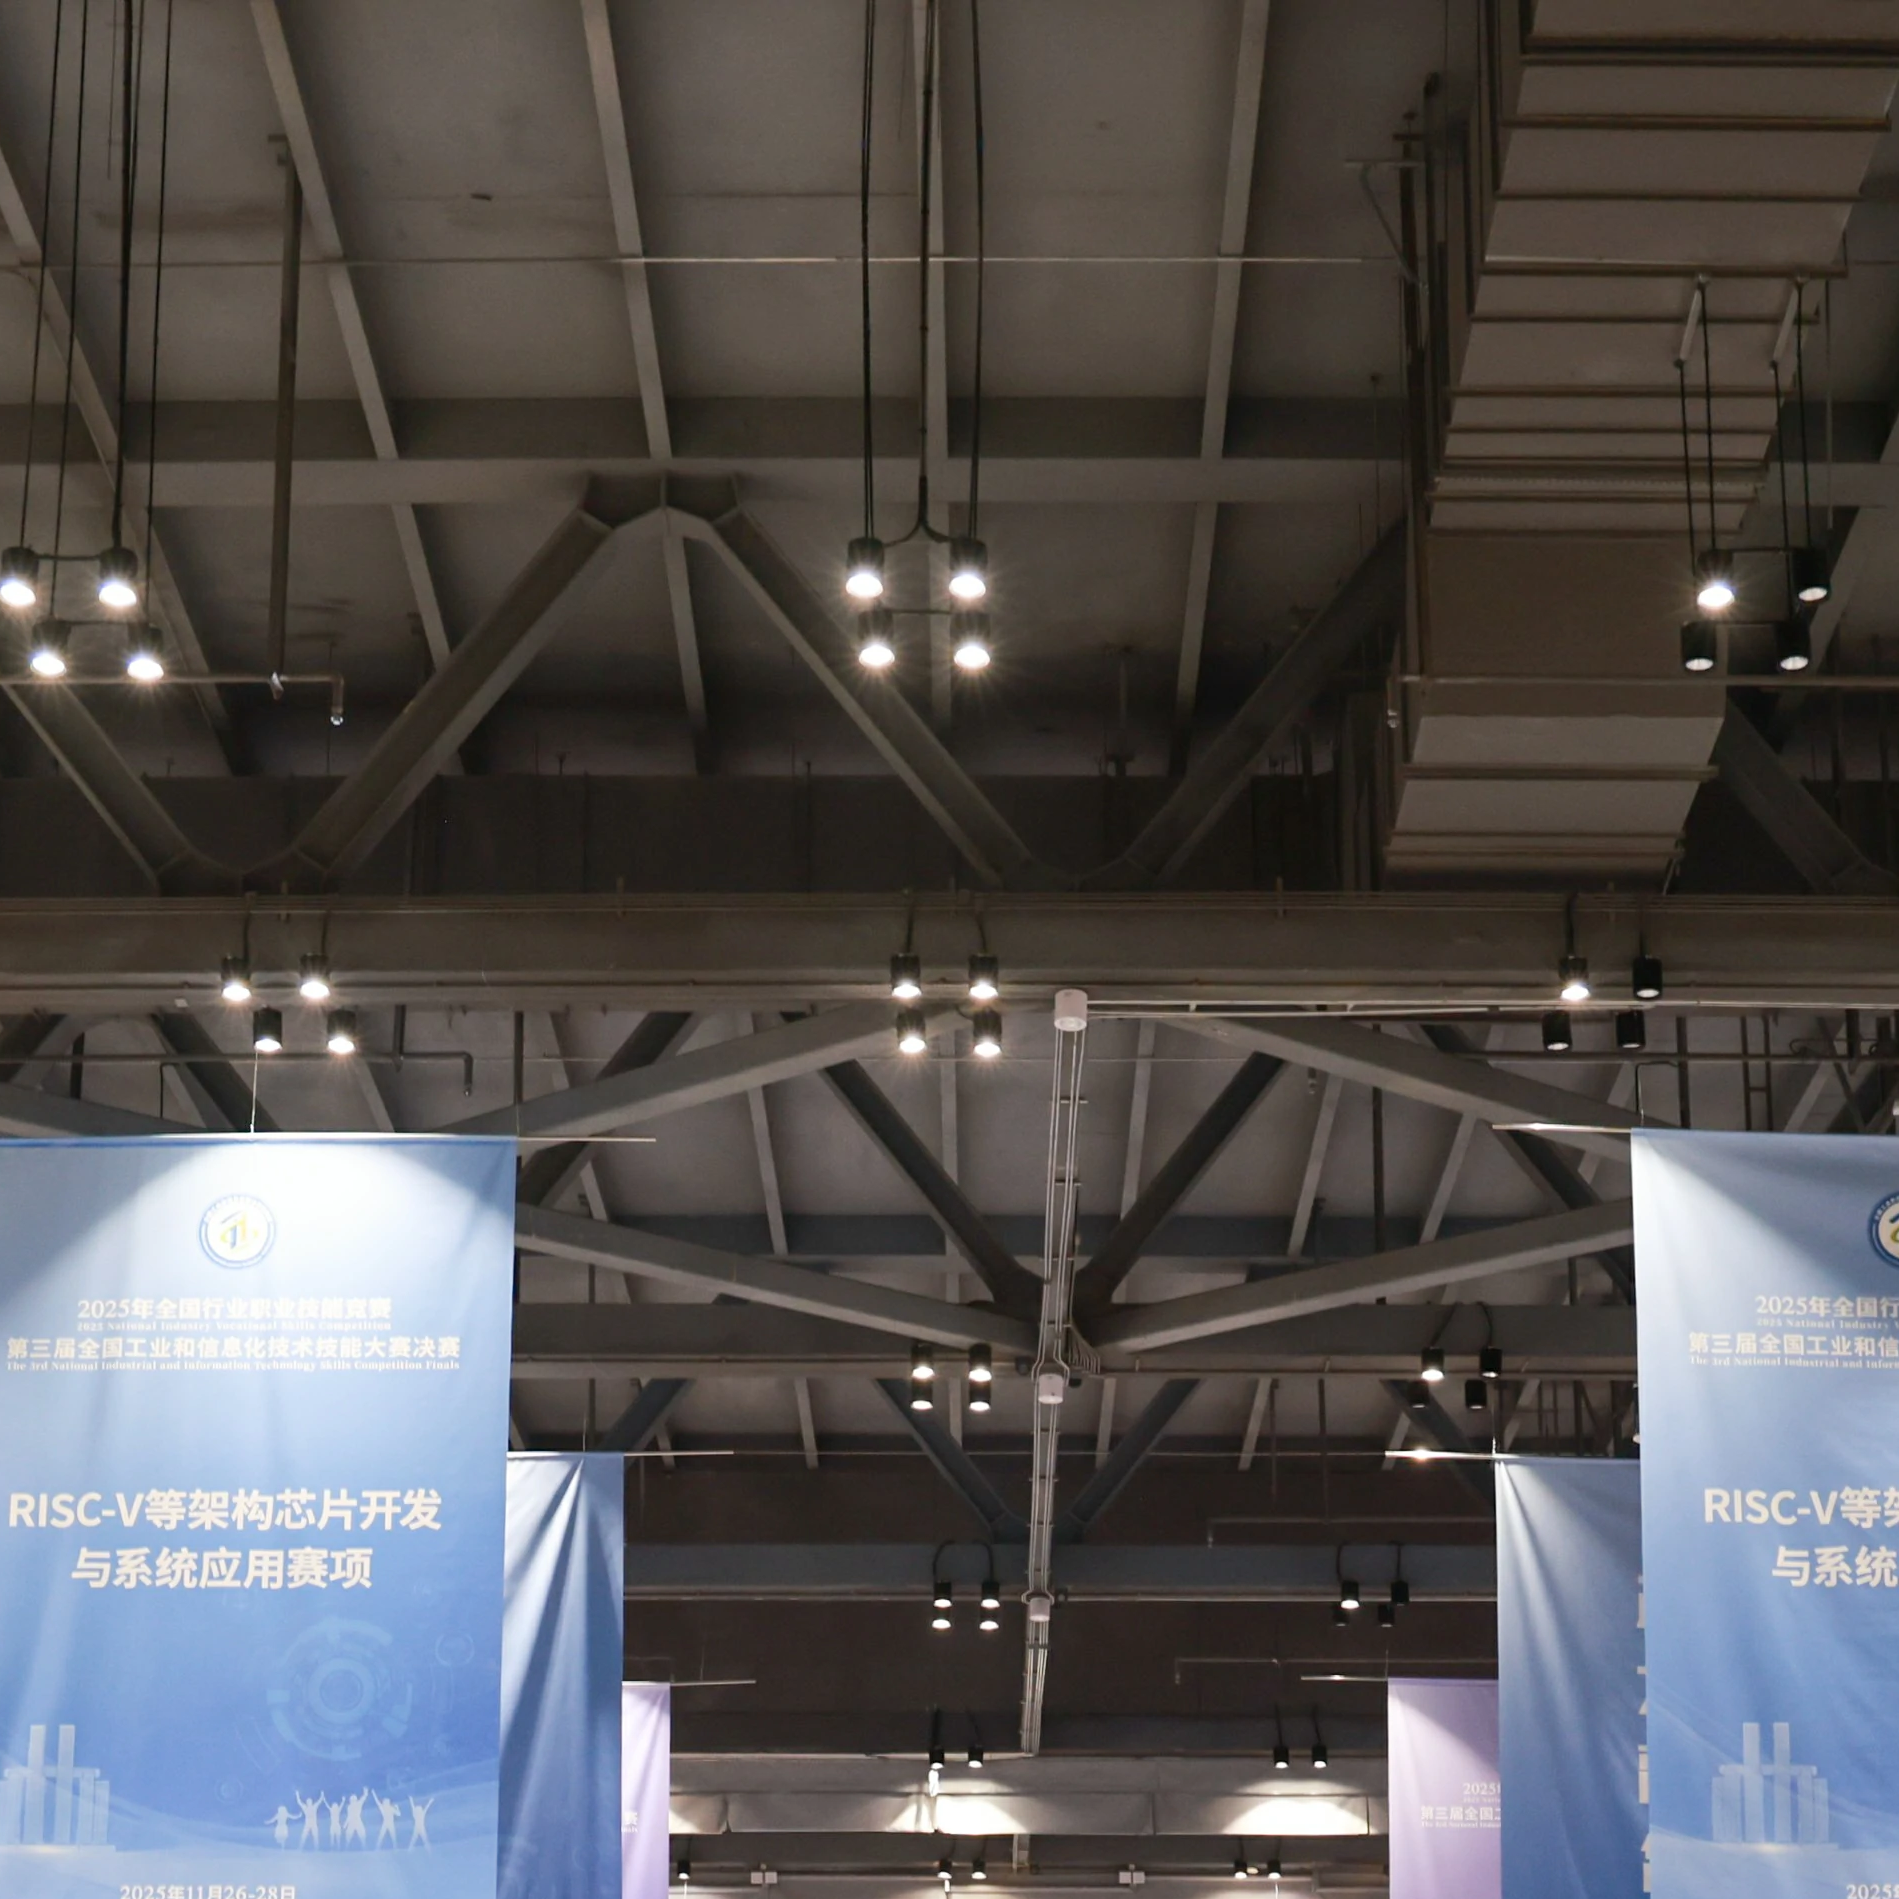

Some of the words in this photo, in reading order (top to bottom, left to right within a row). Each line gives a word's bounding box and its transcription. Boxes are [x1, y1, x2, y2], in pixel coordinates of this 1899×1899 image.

[77, 1296, 392, 1320] 2025年全国行业职业技能竞赛
[7, 1336, 460, 1360] 第三届全国工业和信息化技术技能大赛决赛
[8, 1489, 443, 1533] RISC-V等架构芯片开发
[71, 1547, 373, 1591] 与系统应用赛项
